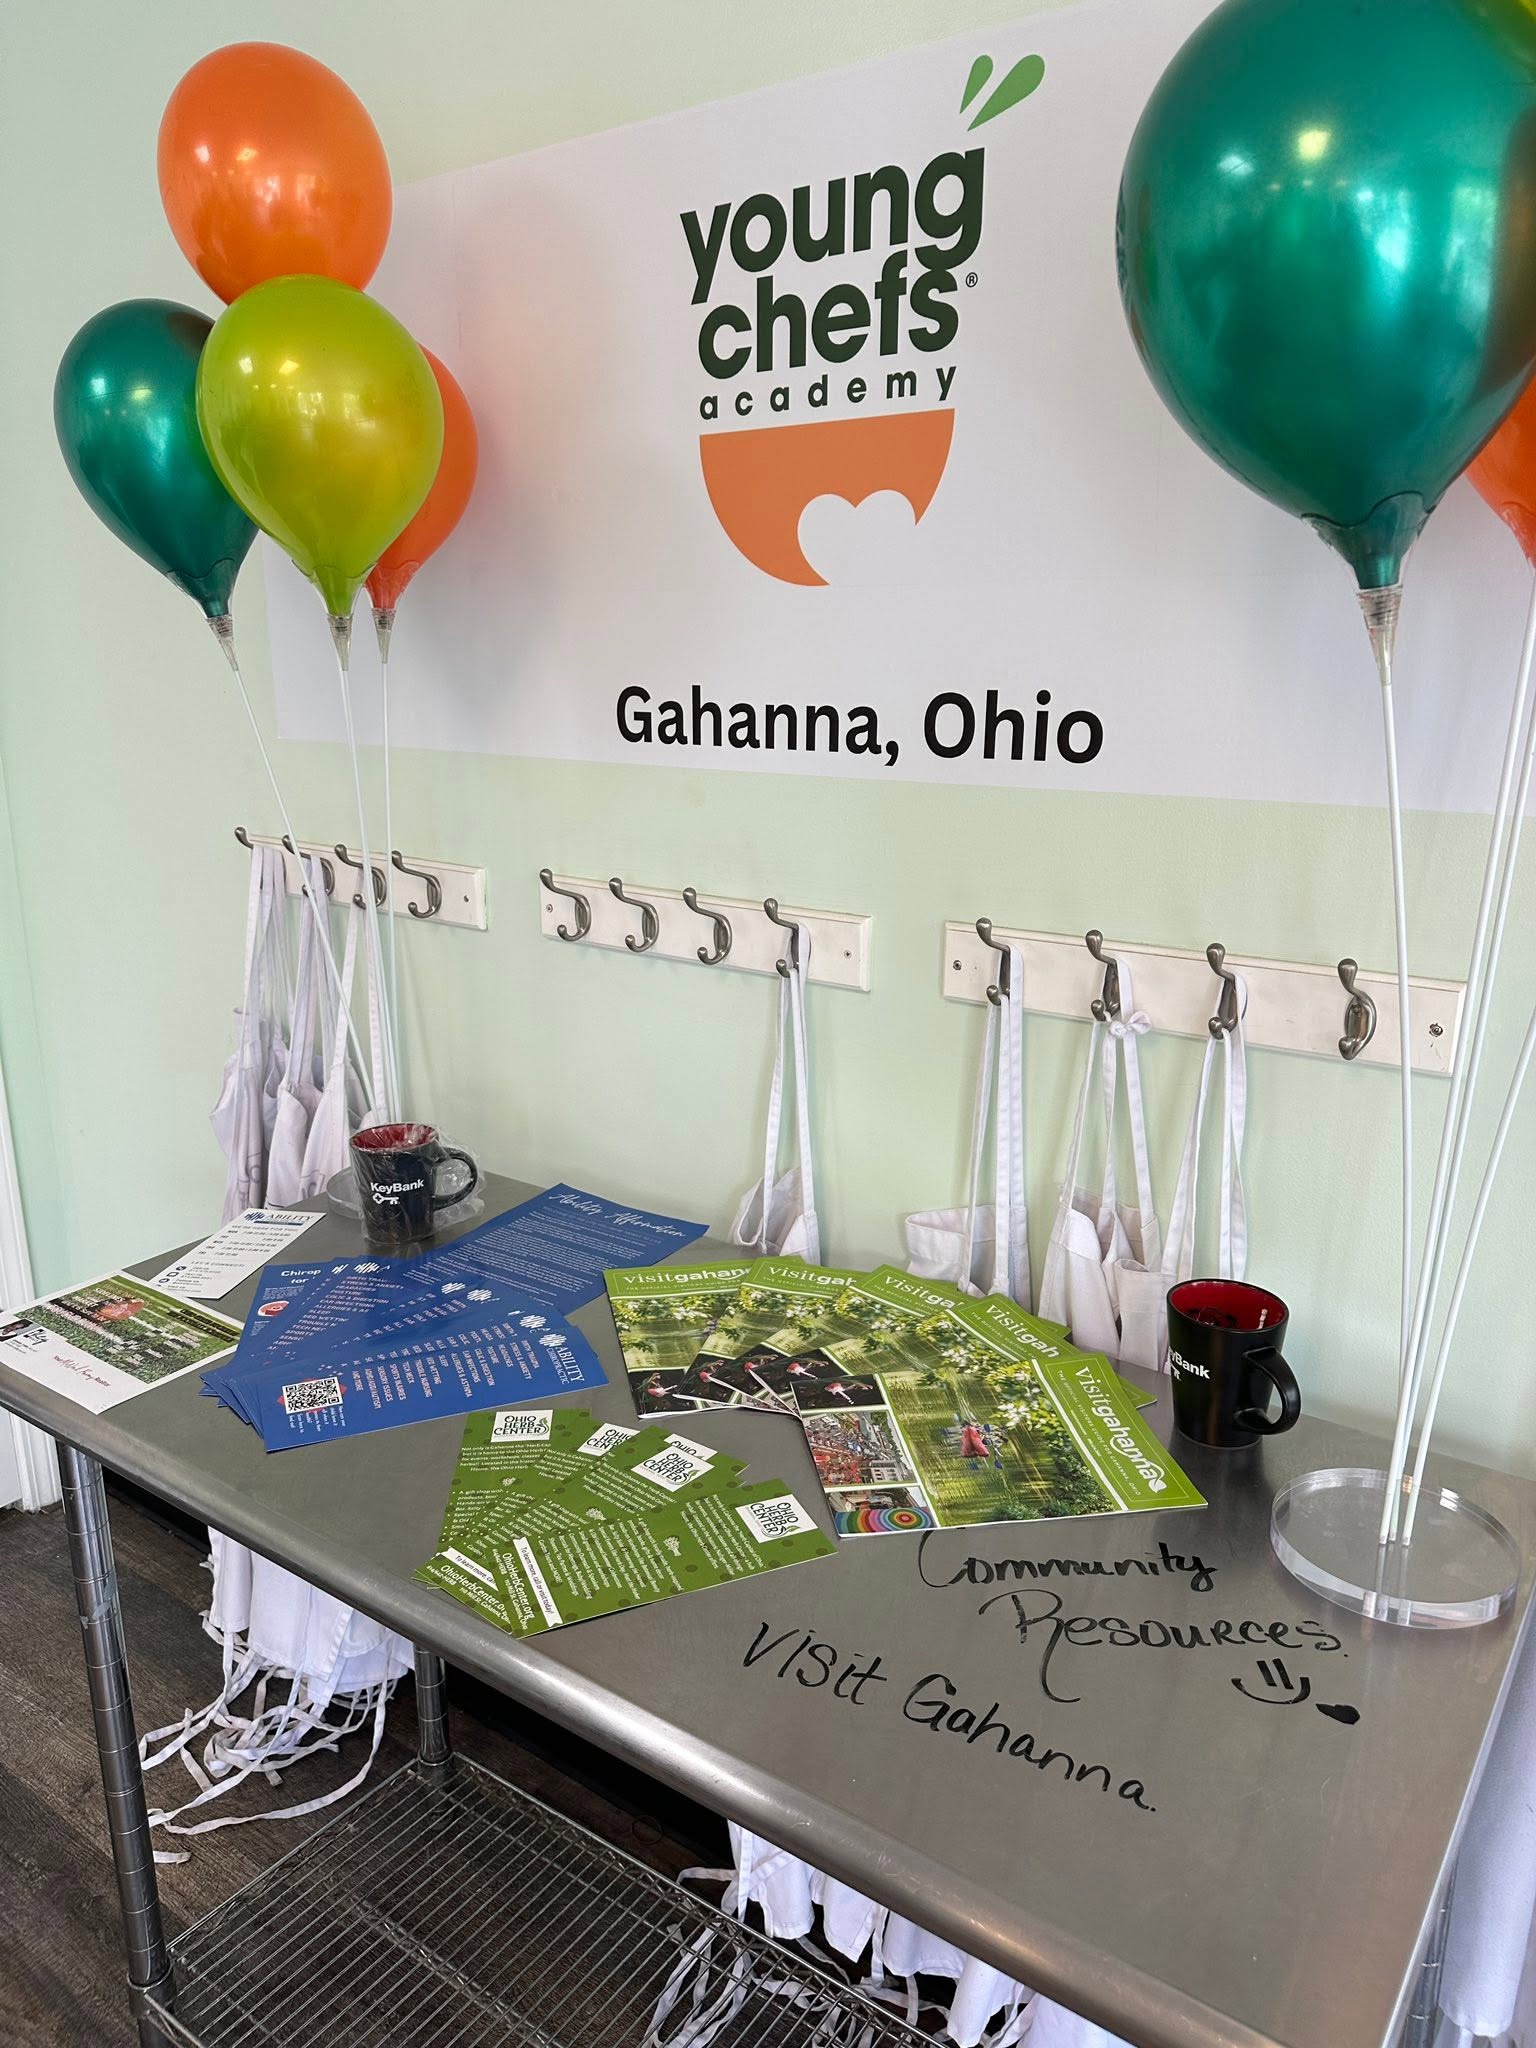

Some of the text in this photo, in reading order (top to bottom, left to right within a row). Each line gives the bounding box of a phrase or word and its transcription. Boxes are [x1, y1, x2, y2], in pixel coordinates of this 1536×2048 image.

[680, 147, 985, 305] young
[698, 249, 958, 380] chefs
[700, 366, 956, 420] academy
[616, 685, 1103, 767] Gahanna, Ohio
[370, 1179, 424, 1194] KeyBank
[548, 1194, 603, 1215] Ability
[604, 1212, 686, 1237] Affirmation
[439, 1355, 449, 1367] SLEEP
[488, 1346, 499, 1363] POSTURE
[499, 1344, 513, 1367] HEADACHES
[547, 1348, 569, 1384] CHIROPRACTIC
[556, 1347, 584, 1381] ABILITY
[1168, 1346, 1210, 1379] yBank
[390, 1364, 406, 1400] SPORTS INJURIES
[403, 1362, 415, 1383] TECH NECK
[430, 1365, 442, 1384] WETTING
[452, 1353, 464, 1373] ALLERGIES
[461, 1378, 472, 1397] ASTHMA
[466, 1359, 480, 1383] INFECTIONS
[481, 1363, 495, 1386] DIGESTION
[519, 1361, 532, 1379] ANXIETY
[355, 1379, 364, 1391] MORE
[383, 1385, 393, 1401] ISSUES
[494, 1427, 541, 1435] CENTER
[504, 1415, 536, 1423] OHIO
[1058, 1370, 1066, 1380] THE
[1078, 1405, 1094, 1426] VISITORS
[1092, 1428, 1105, 1443] GUIDE
[1103, 1445, 1112, 1454] FOR
[1110, 1456, 1129, 1481] GAHANNA,
[1129, 1483, 1141, 1495] OHIO
[1075, 1366, 1162, 1481] visitgahanna
[643, 1460, 682, 1482] CENTER
[657, 1459, 685, 1475] HERB
[666, 1453, 694, 1469] OHIO
[751, 1503, 781, 1533] CENTER
[765, 1506, 787, 1525] HERB
[777, 1503, 799, 1523] OHIO
[462, 1560, 474, 1571] learn
[918, 1526, 1217, 1593] Community
[440, 1565, 507, 1616] OhioHerbCenter.o
[503, 1553, 534, 1620] OhioHerbCenter.org
[523, 1553, 532, 1564] learn
[528, 1564, 536, 1577] more,
[539, 1590, 547, 1600] visit
[543, 1599, 554, 1614] today!
[513, 1599, 525, 1619] Gahanna,
[520, 1618, 528, 1630] Ohio
[742, 1621, 887, 1706] Visit
